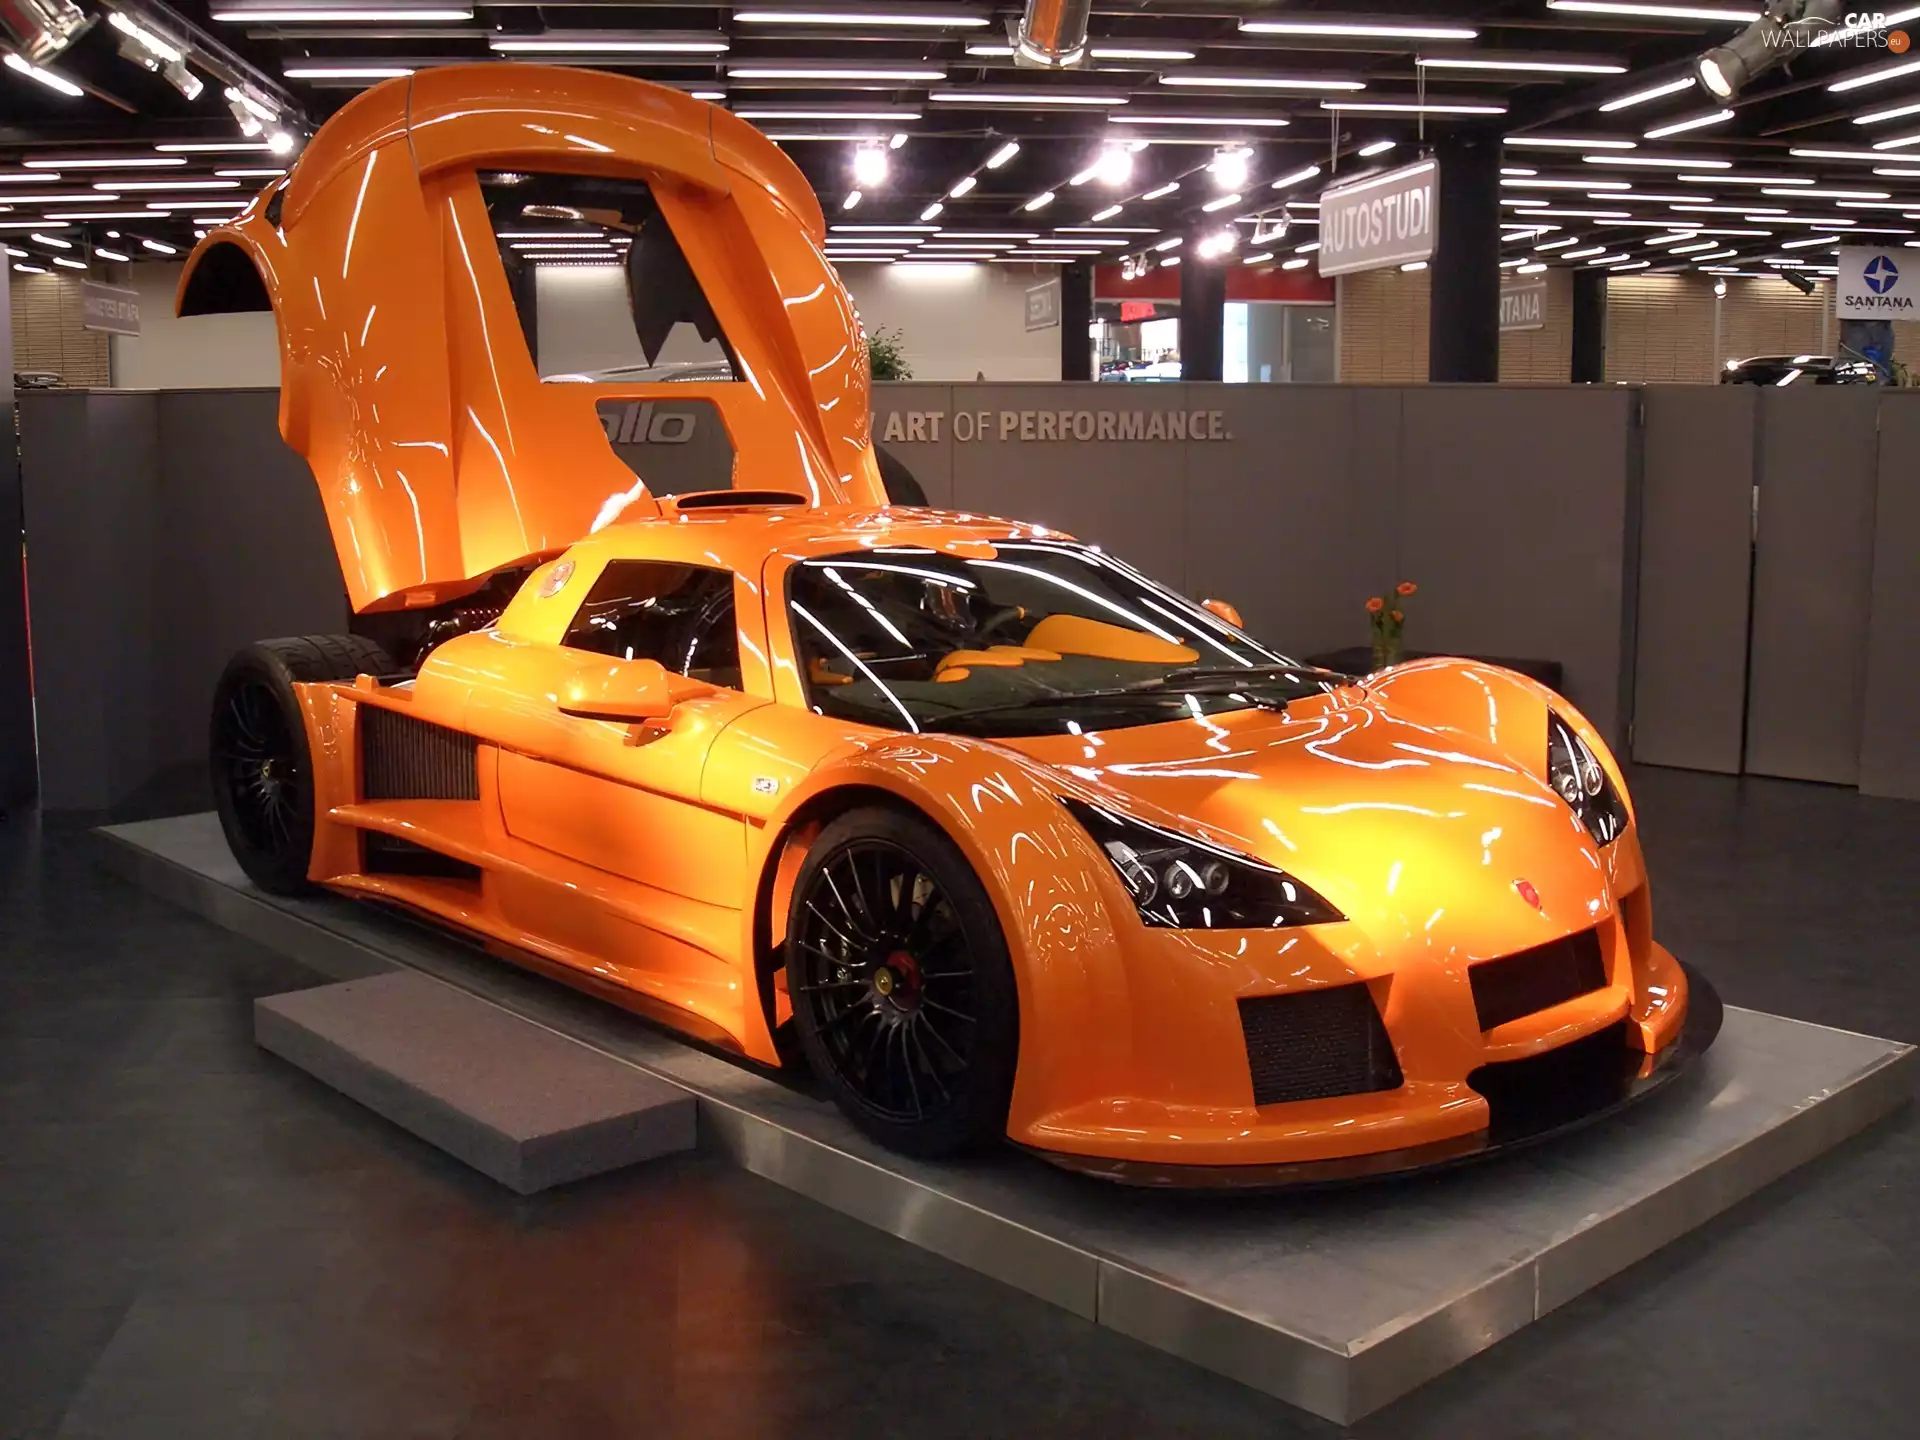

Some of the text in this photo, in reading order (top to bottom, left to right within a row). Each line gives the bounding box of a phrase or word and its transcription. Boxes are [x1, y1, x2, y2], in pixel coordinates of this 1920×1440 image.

[1323, 186, 1431, 255] AUTOSTUDI
[1845, 295, 1914, 309] SANTANA
[882, 411, 945, 442] ART
[953, 411, 991, 442] OF
[1000, 410, 1233, 442] PERFORMANCE.
